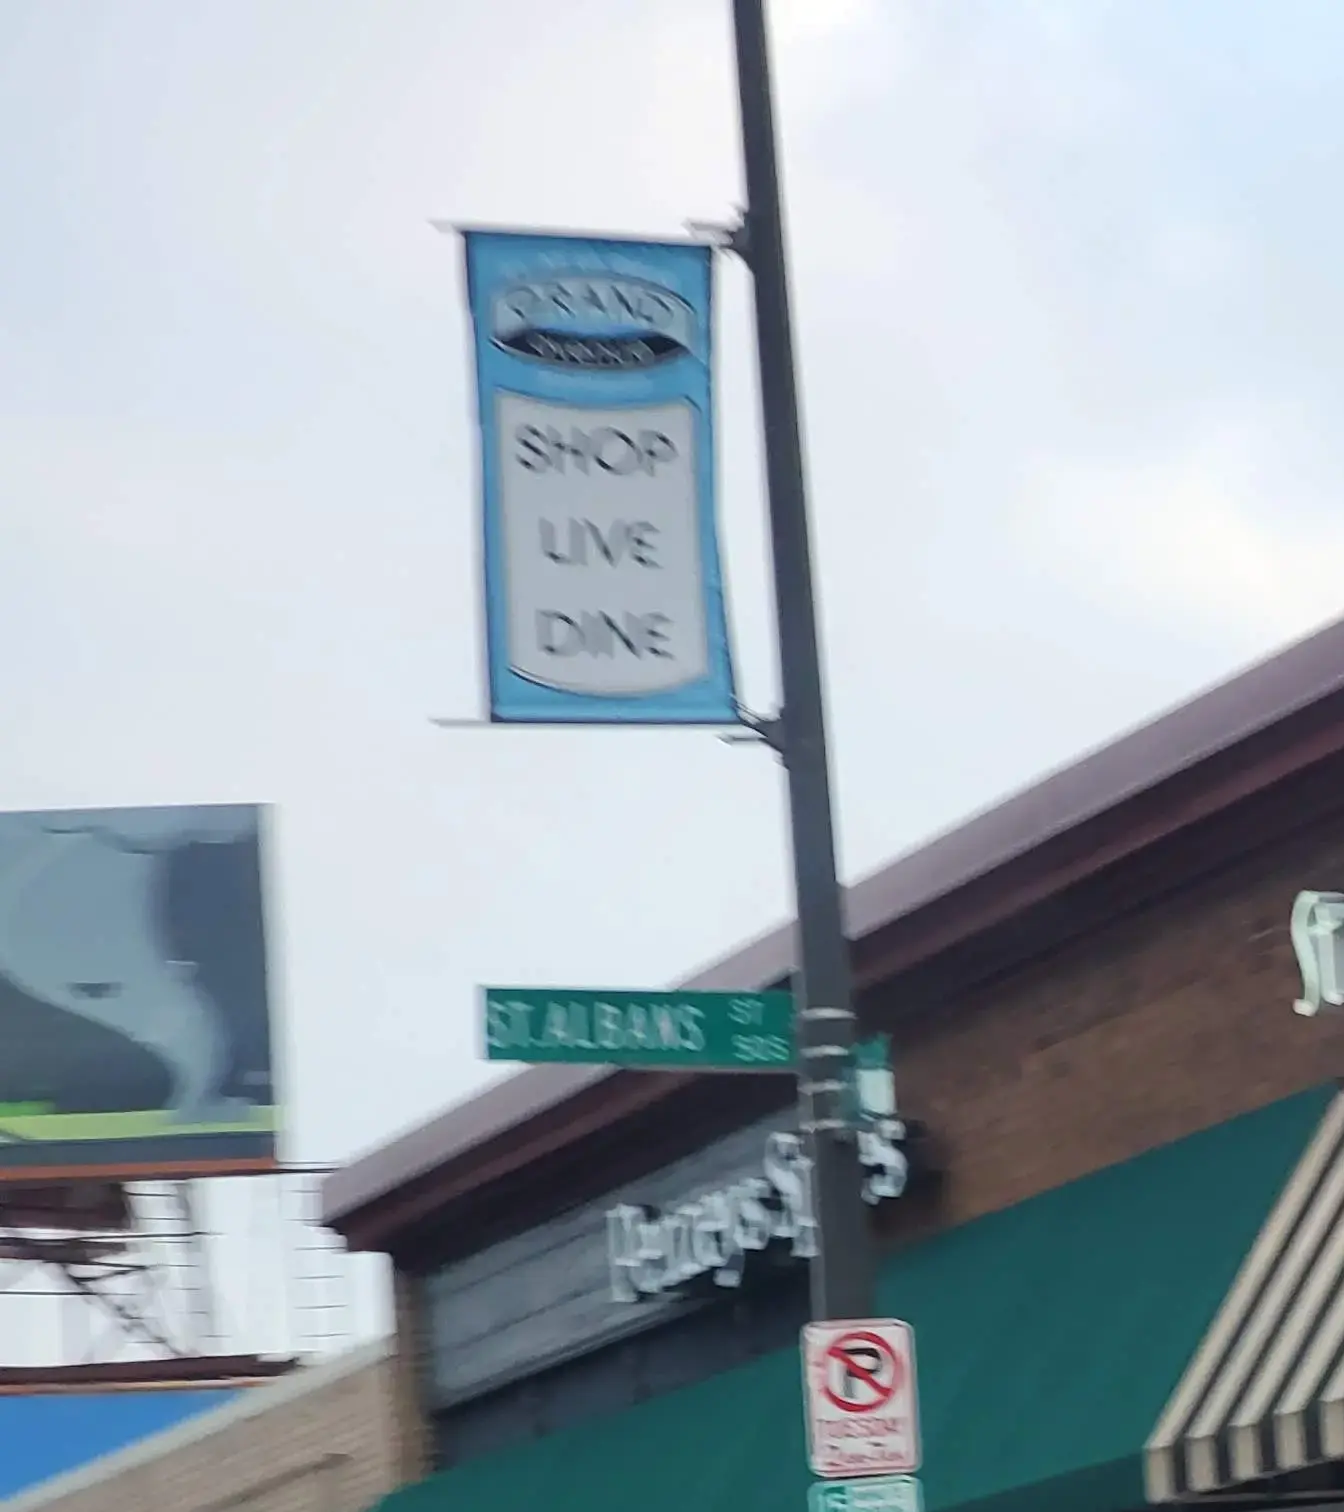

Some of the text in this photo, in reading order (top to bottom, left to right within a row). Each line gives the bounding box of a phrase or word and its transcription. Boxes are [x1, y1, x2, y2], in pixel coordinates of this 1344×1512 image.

[515, 424, 677, 478] SHOP
[539, 517, 662, 569] LIVE
[535, 609, 674, 660] DINE
[543, 1000, 706, 1052] ALBANS
